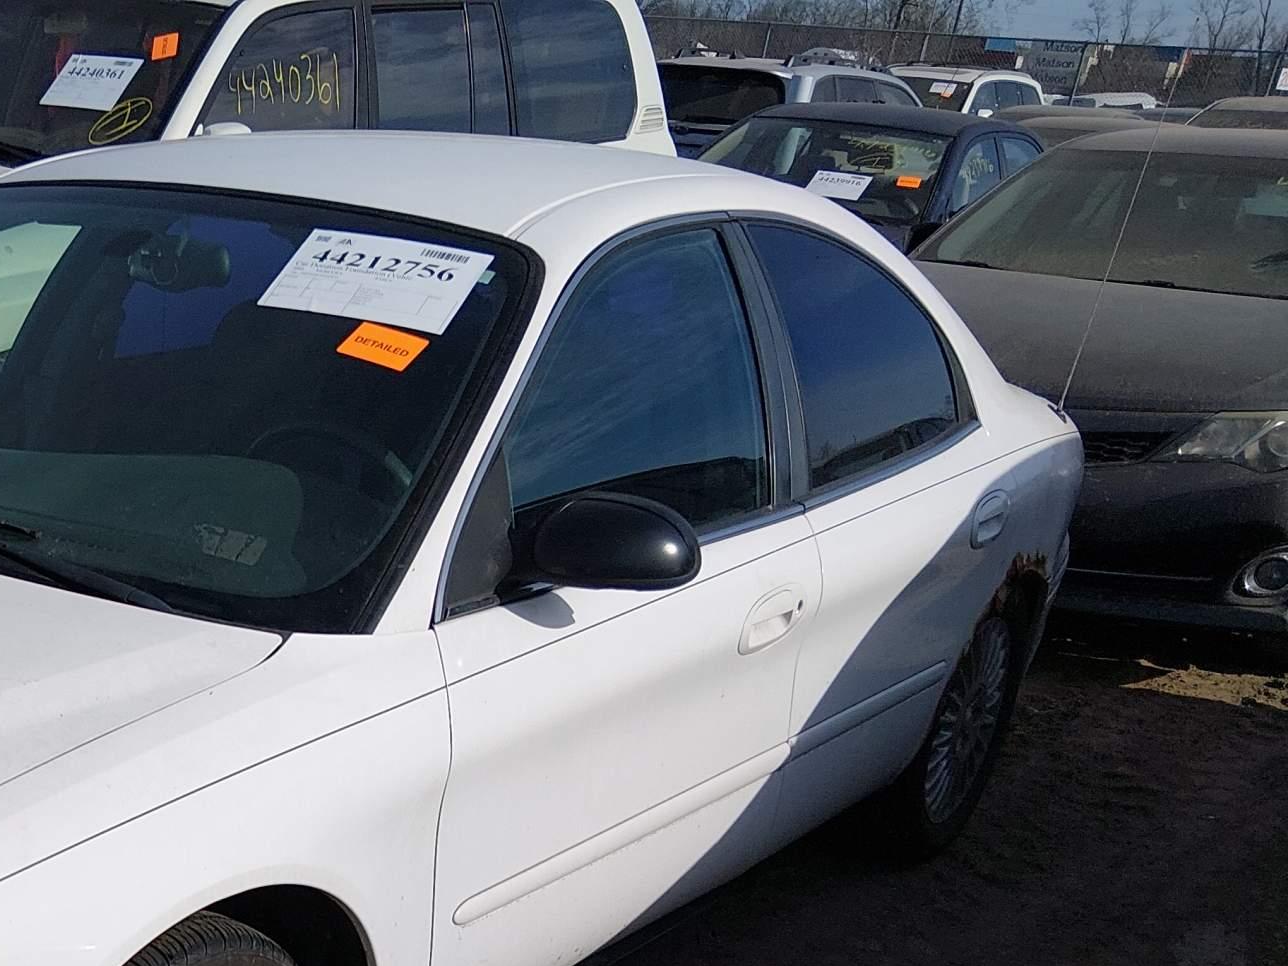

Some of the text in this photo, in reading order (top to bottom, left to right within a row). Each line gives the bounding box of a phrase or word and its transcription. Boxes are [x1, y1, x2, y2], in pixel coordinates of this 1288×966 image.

[67, 66, 125, 79] 44240361
[228, 51, 340, 115] 44240361
[311, 248, 457, 282] 44212756
[354, 335, 409, 357] DETAILED
